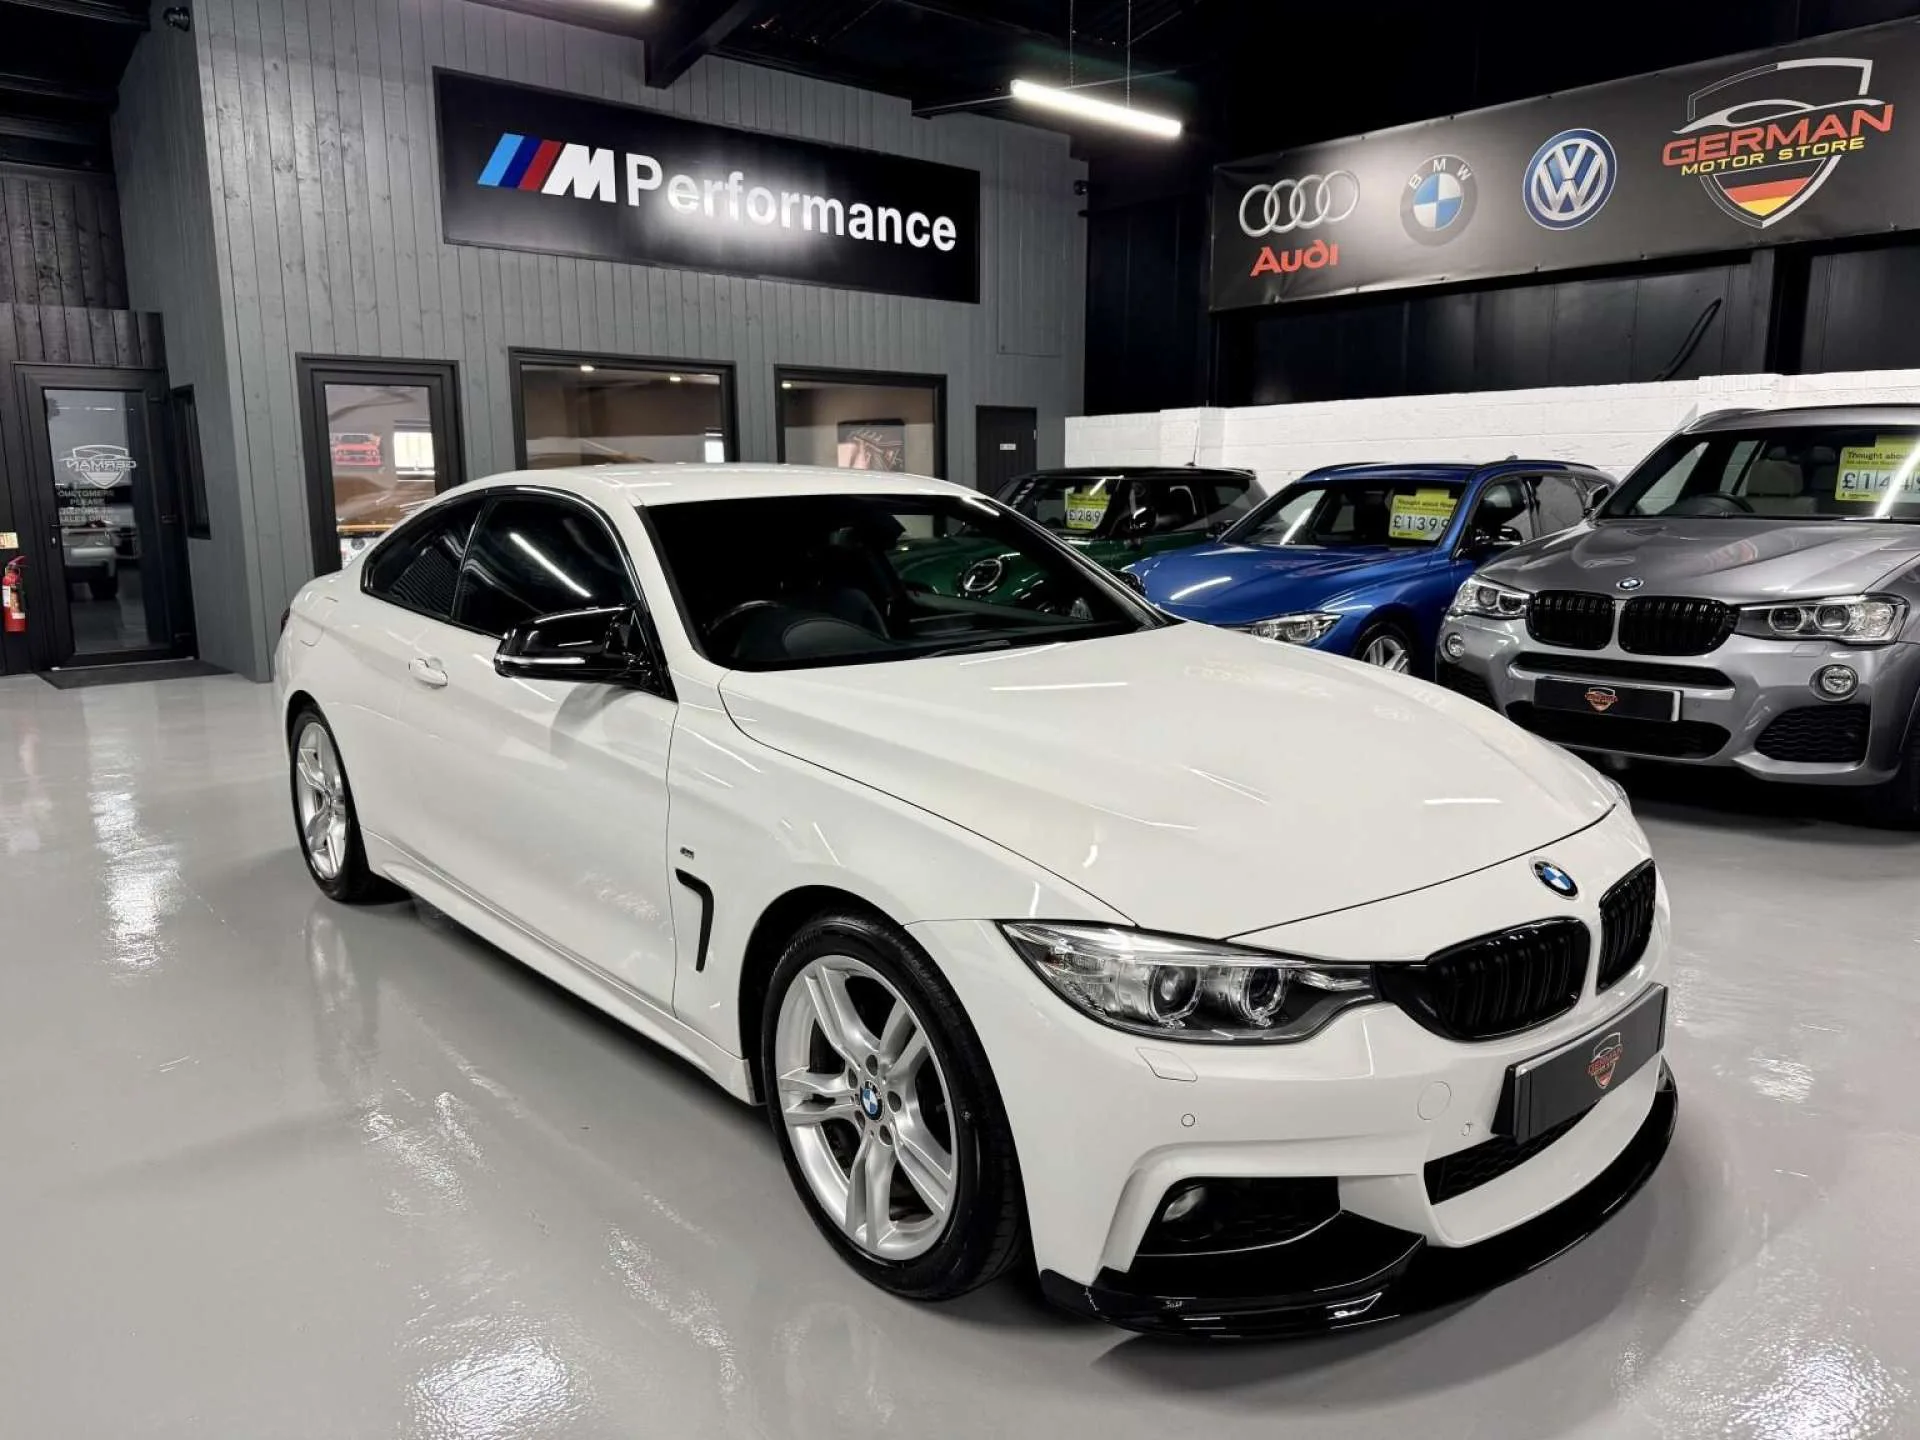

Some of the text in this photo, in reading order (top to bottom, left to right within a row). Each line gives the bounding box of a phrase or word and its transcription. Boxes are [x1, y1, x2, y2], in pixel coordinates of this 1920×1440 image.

[1662, 104, 1894, 167] GERMAN
[1681, 136, 1866, 177] MOTOR STORE
[541, 142, 957, 252] M Performance
[1408, 158, 1472, 191] BMW
